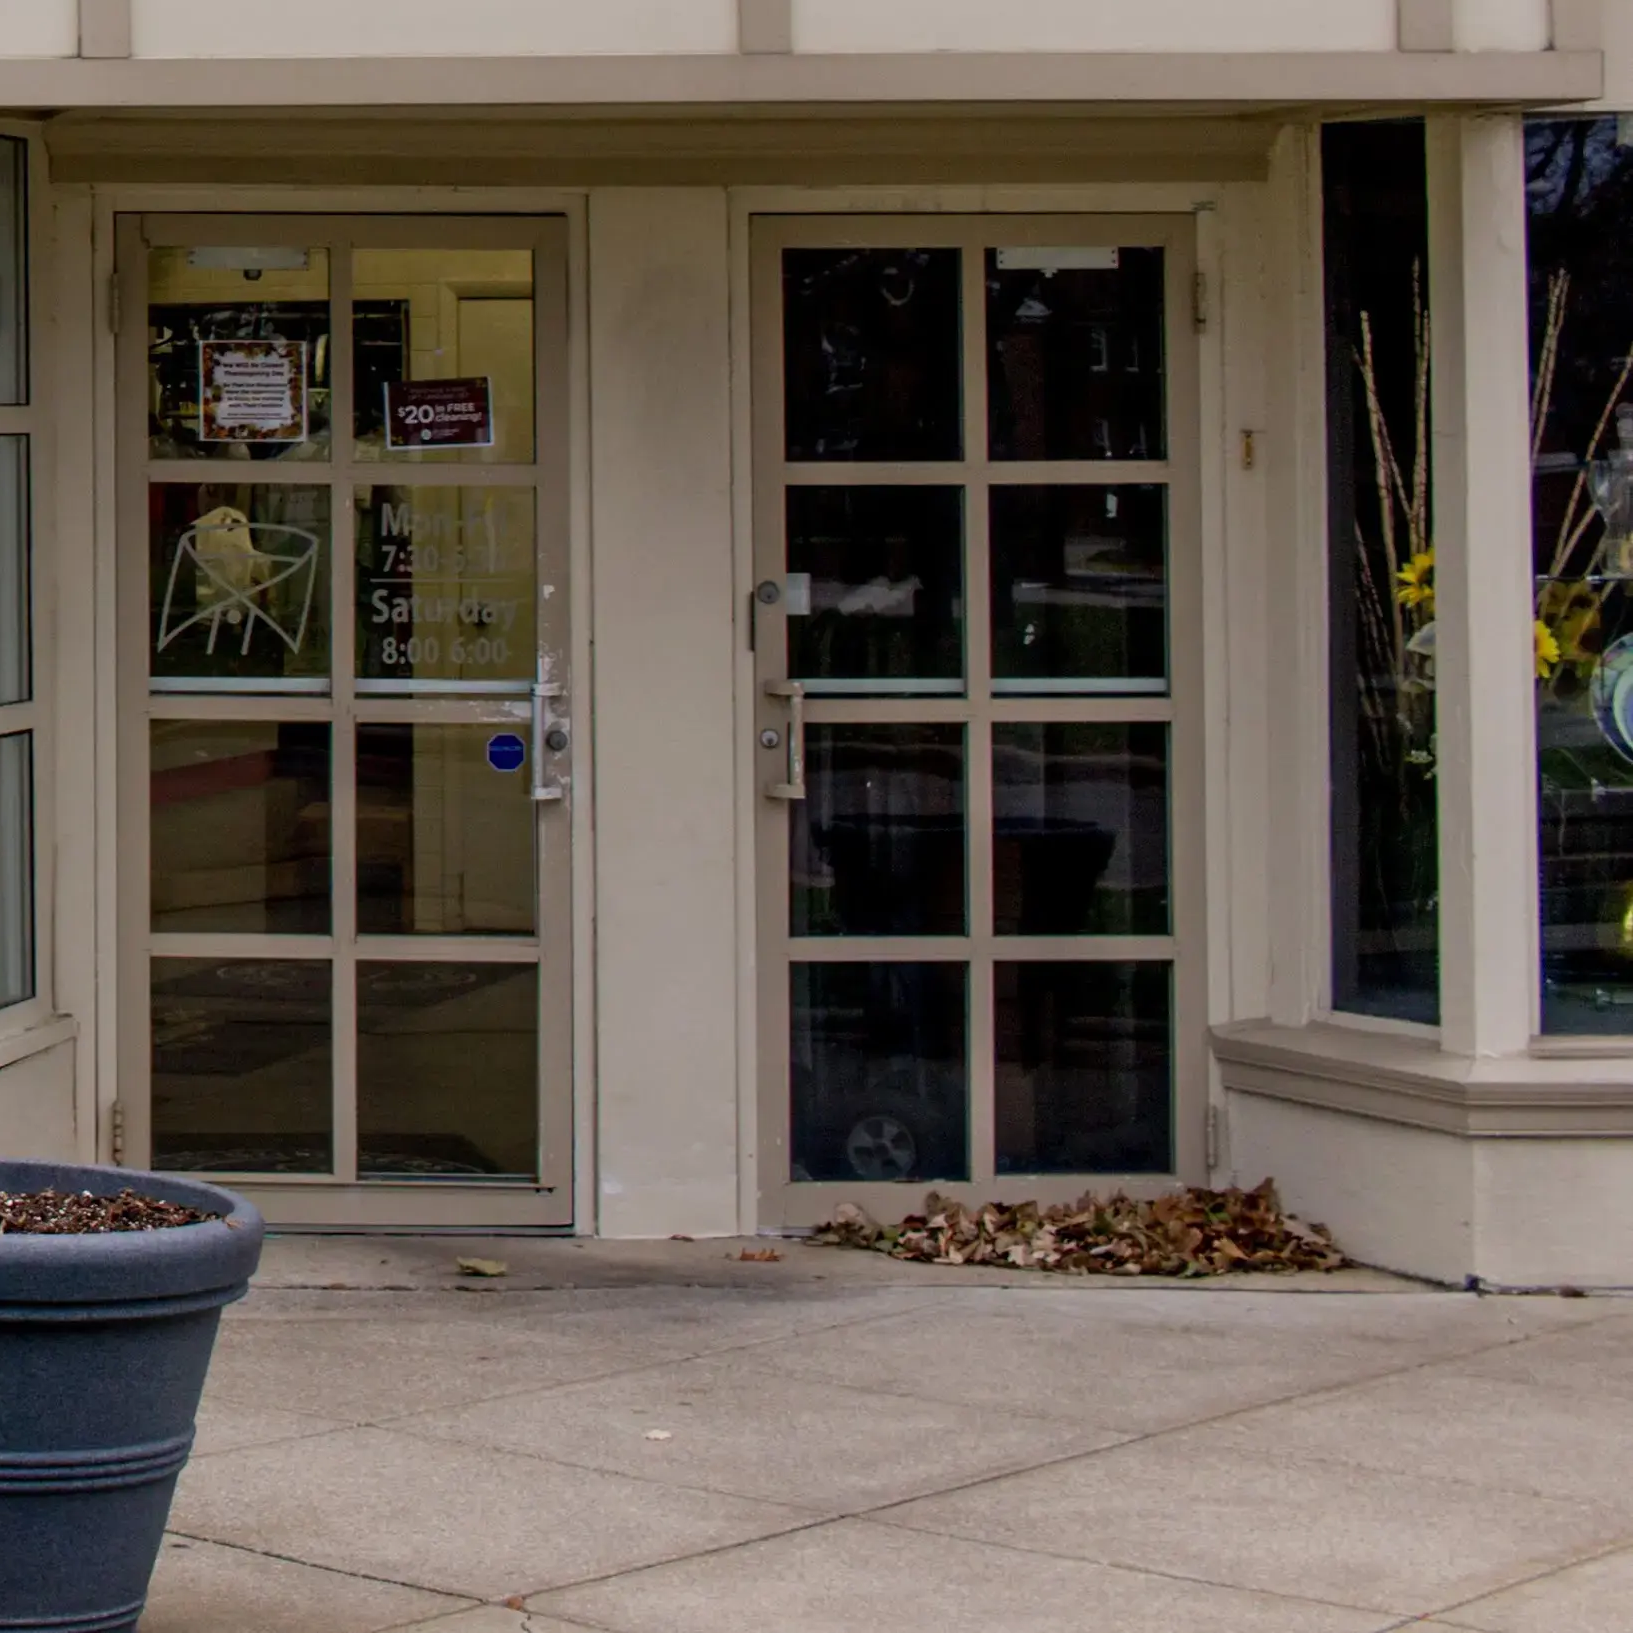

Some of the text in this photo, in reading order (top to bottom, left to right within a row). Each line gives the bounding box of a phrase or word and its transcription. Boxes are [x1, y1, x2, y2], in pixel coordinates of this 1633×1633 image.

[397, 404, 435, 424] $20
[446, 402, 476, 413] FREE
[371, 588, 518, 632] Saturday
